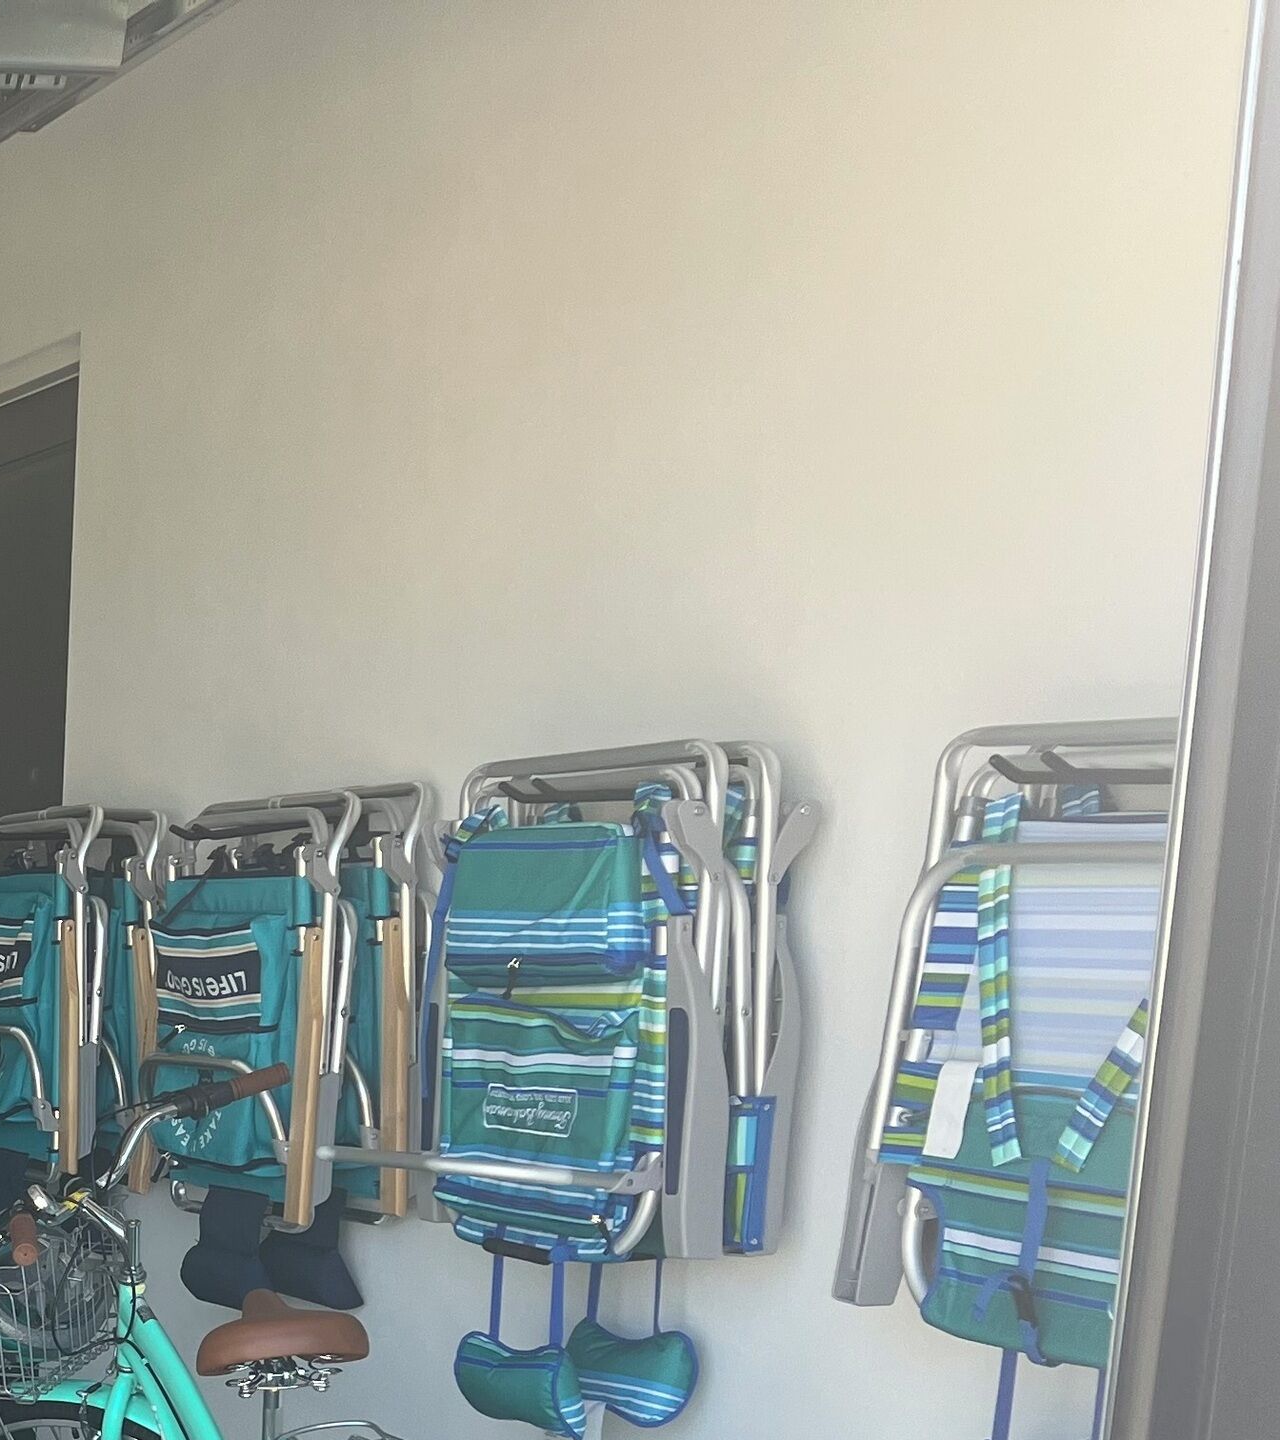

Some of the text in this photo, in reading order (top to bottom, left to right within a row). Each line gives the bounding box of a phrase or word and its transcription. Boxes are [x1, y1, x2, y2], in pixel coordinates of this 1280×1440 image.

[191, 977, 207, 997] IS
[171, 1117, 191, 1147] EAS
[199, 1110, 222, 1149] TAKE
